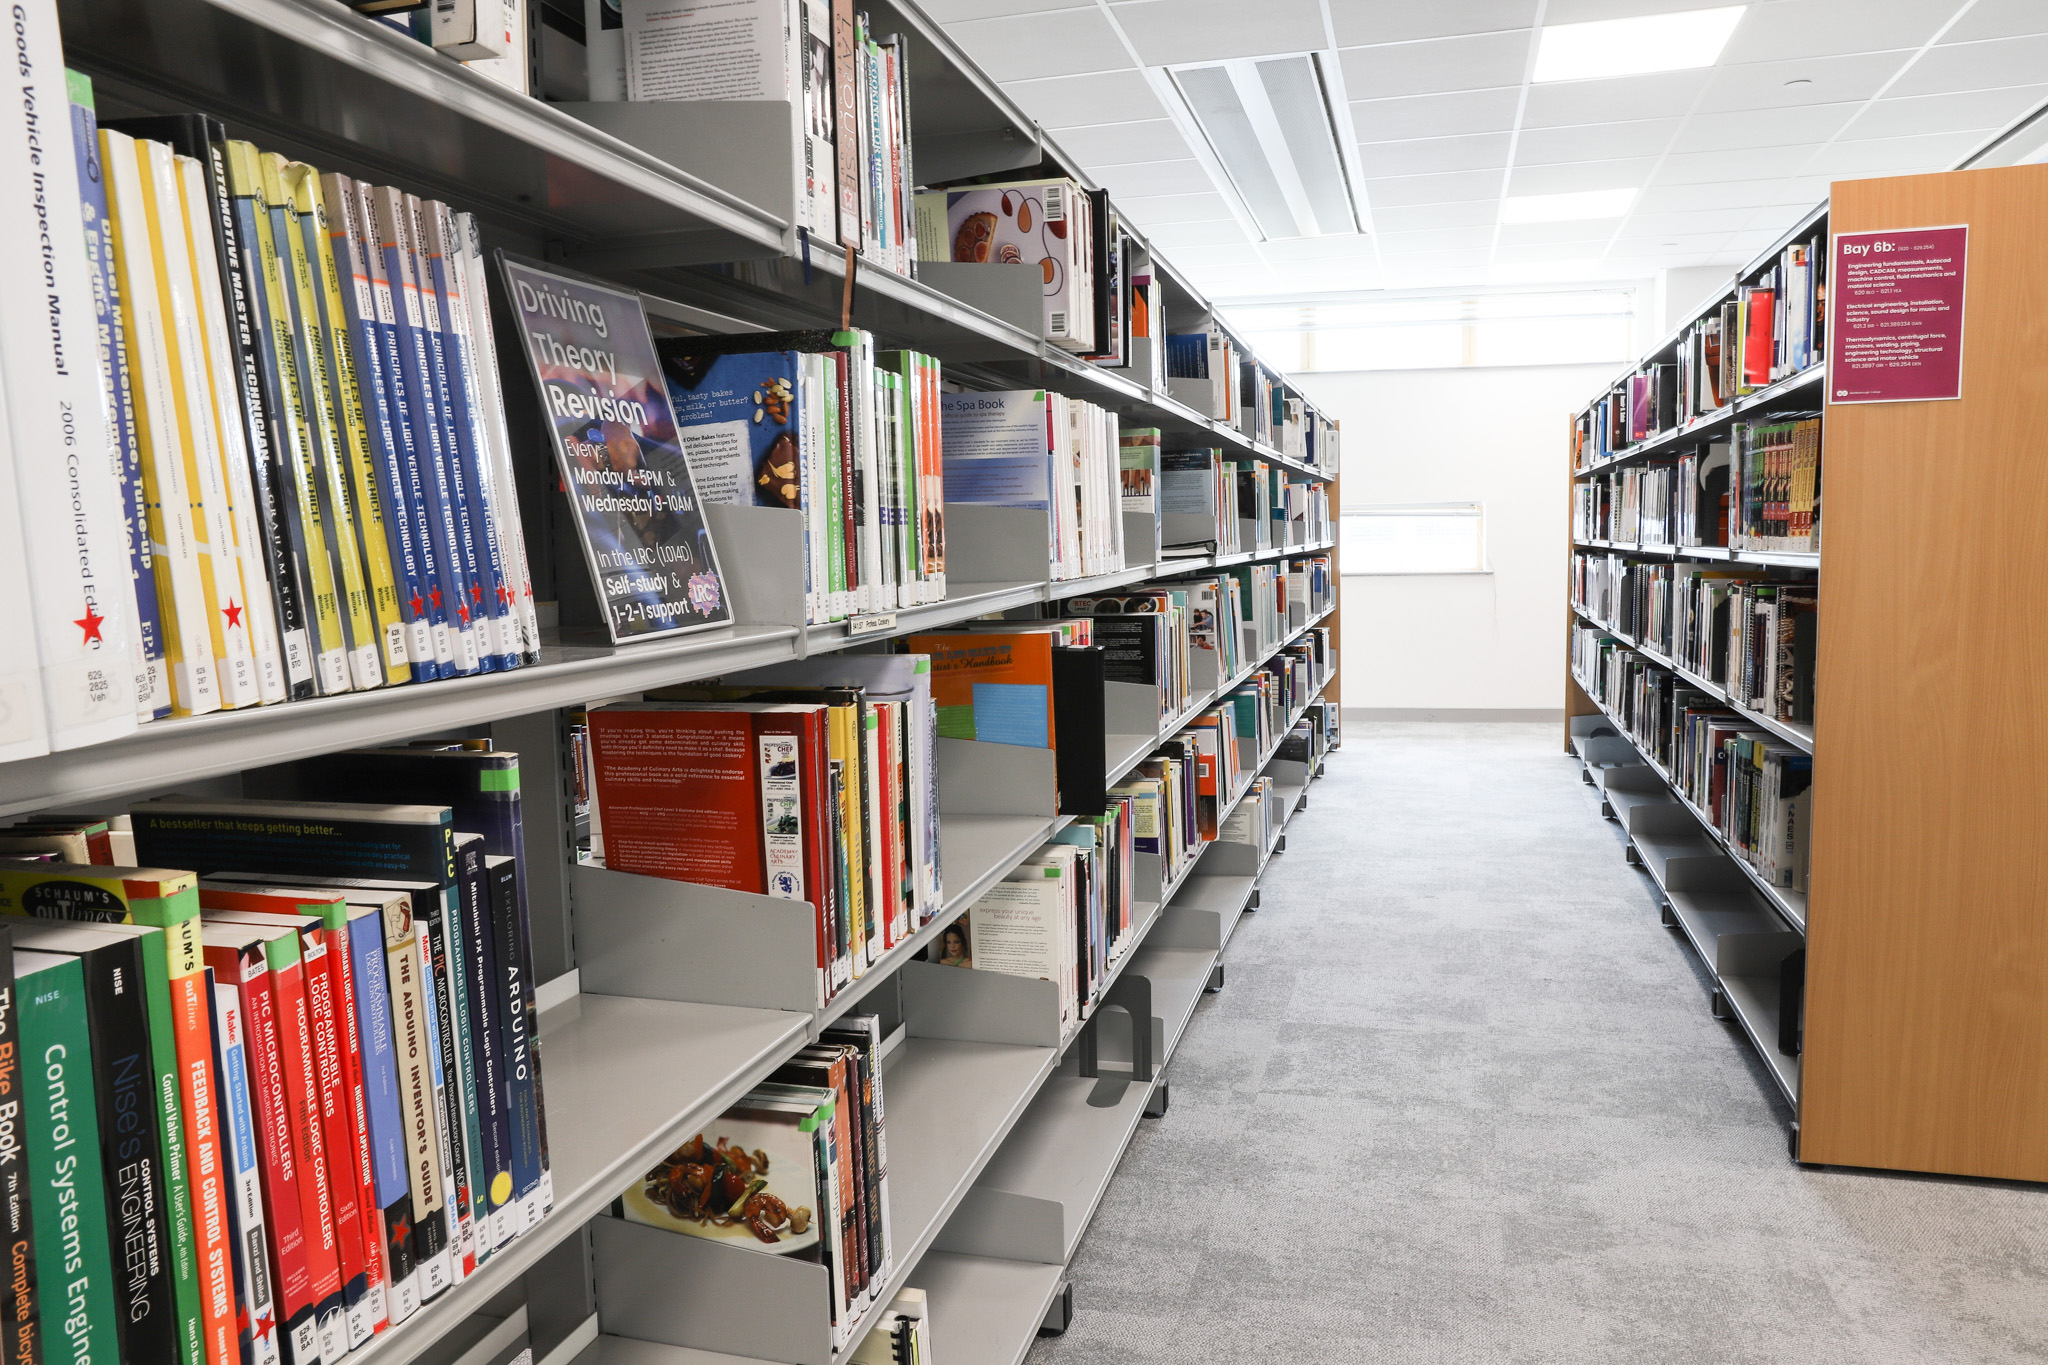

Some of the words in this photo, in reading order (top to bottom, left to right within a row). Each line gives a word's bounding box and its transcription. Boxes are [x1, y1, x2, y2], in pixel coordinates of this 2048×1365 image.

[12, 4, 31, 78] Goods
[842, 18, 855, 188] LAROUSSE
[22, 85, 41, 164] Vehicle
[33, 171, 55, 288] Inspection
[1843, 244, 1870, 256] Bay
[1874, 242, 1896, 252] 6b:
[516, 280, 608, 338] Driving
[48, 294, 69, 376] Manual
[1846, 335, 1896, 343] Thermodynamics,
[211, 147, 239, 268] AUTOMOTIVE
[231, 272, 251, 345] MASTER
[243, 353, 270, 461] TECHNICIAN
[268, 494, 287, 575] GRAHAM
[415, 333, 431, 397] PRINCIPLES
[532, 332, 616, 385] Theory
[101, 219, 119, 298] Diesel
[111, 304, 139, 471] Maintenance,
[132, 476, 151, 569] Tune-up
[426, 403, 435, 418] OF
[549, 385, 647, 425] Revision
[687, 403, 705, 411] milk,
[719, 397, 748, 406] butter?
[957, 401, 975, 412] Spa
[979, 399, 1004, 409] Book
[59, 400, 77, 446] 2006
[681, 411, 713, 422] problem!
[799, 409, 808, 459] VEGAN
[430, 423, 442, 453] LIGHT
[565, 438, 602, 459] Every:
[436, 456, 448, 498] VEHICLE
[575, 466, 624, 489] Monday
[627, 467, 663, 487] 4-5PM
[666, 471, 675, 486] &
[800, 462, 809, 503] CAKES
[67, 453, 95, 579] Consolidated
[581, 494, 653, 518] Wednesday
[654, 495, 693, 512] 9-10AM
[444, 504, 461, 573] TECHNOLOGY
[600, 550, 609, 568] In
[610, 549, 630, 567] the
[633, 546, 655, 565] LRC
[606, 573, 669, 597] Self-study
[673, 575, 682, 589] &
[613, 603, 645, 624] 1-2-1
[647, 597, 690, 621] support
[960, 654, 1013, 668] Handbook
[150, 819, 157, 827] A
[160, 819, 211, 829] bestseller
[215, 820, 234, 829] that
[236, 822, 264, 832] keeps
[267, 823, 300, 835] getting
[35, 887, 110, 903] SCHAUM'S
[470, 882, 480, 937] Mitsubishi
[855, 890, 863, 927] FOOD
[307, 947, 324, 959] BOLTON
[433, 934, 442, 953] THE
[451, 909, 464, 1001] PROGRAMMABLE
[476, 939, 482, 953] FX
[113, 967, 123, 995] NISE
[248, 964, 264, 978] BATES
[400, 954, 410, 984] THE
[434, 954, 445, 977] PIC
[35, 990, 60, 1005] NISE
[260, 990, 271, 1018] PIC
[310, 977, 323, 1019] LOGIC
[477, 956, 488, 1028] Programmable
[226, 1009, 236, 1045] Make:
[319, 972, 340, 1088] PROGRAMMABLE
[403, 991, 417, 1058] ARDUINO
[437, 977, 453, 1066] MICROCONTROLLER
[507, 966, 527, 1081] ARDUINO
[231, 1049, 241, 1078] Getting
[296, 998, 316, 1112] PROGRAMMABLE
[316, 1022, 334, 1117] CONTROLLERS
[45, 1044, 76, 1151] Control
[162, 1073, 175, 1111] Control
[191, 1060, 211, 1140] FEEDBACK
[235, 1081, 246, 1113] Started
[263, 1022, 292, 1181] MICROCONTROLLERS
[354, 1084, 365, 1134] ENGINEERING
[410, 1065, 427, 1155] INVENTOR'S
[166, 1114, 177, 1143] Valve
[239, 1115, 247, 1133] with
[308, 1115, 321, 1157] LOGIC
[170, 1144, 181, 1180] Primer
[199, 1142, 215, 1175] AND
[239, 1135, 248, 1168] Arduino
[359, 1135, 371, 1186] APPLICATIONS
[866, 1121, 875, 1176] SCIENCE
[141, 1159, 154, 1216] CONTROL
[314, 1157, 332, 1250] CONTROLLERS
[421, 1160, 433, 1206] GUIDE
[50, 1155, 82, 1274] Systems
[202, 1177, 219, 1248] CONTROL
[869, 1189, 878, 1227] SPICE
[118, 1162, 150, 1323] ENGINEERING
[145, 1219, 159, 1276] SYSTEMS
[208, 1248, 228, 1319] SYSTEMS
